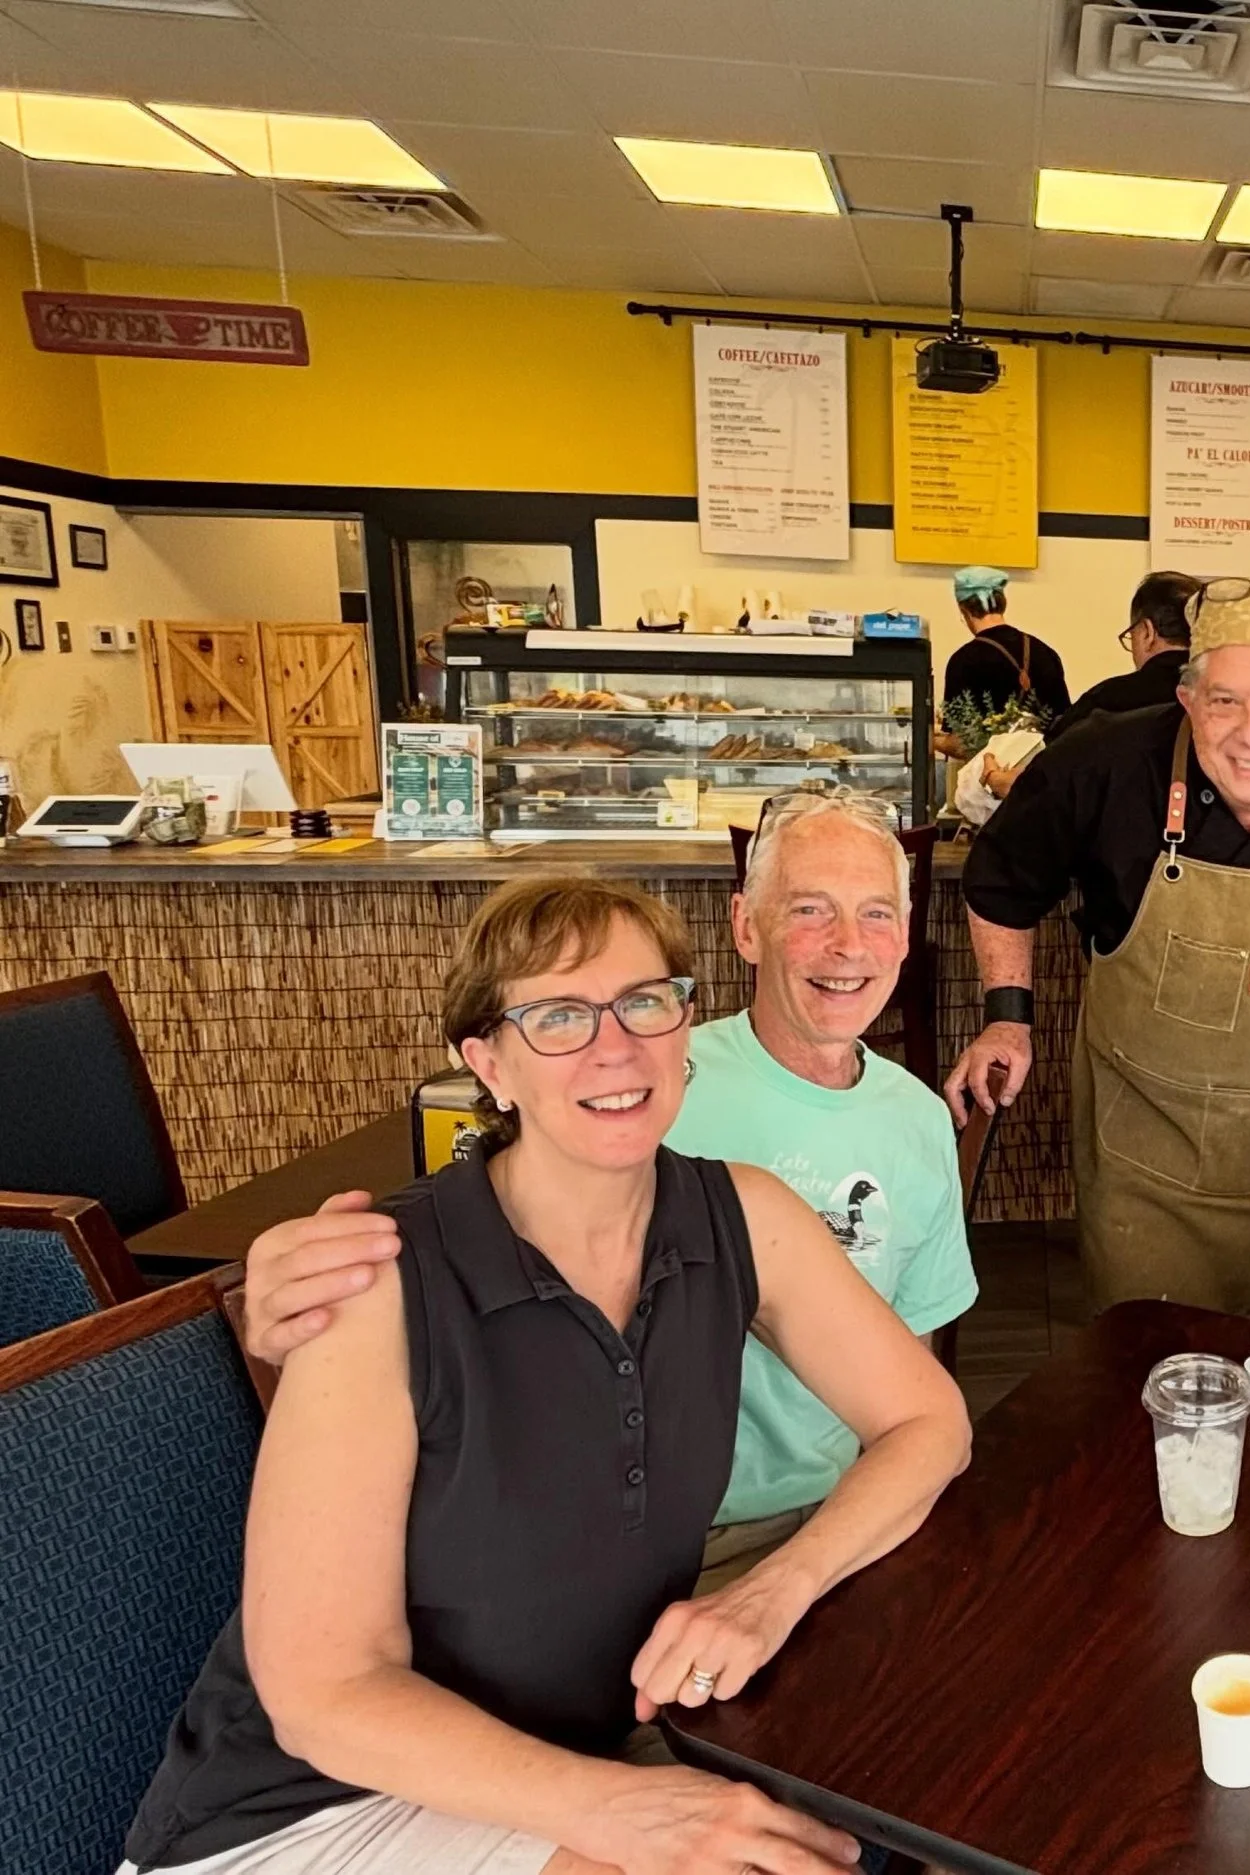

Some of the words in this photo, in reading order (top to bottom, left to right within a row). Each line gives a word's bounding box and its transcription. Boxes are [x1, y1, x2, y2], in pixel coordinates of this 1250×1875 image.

[46, 309, 163, 342] COFFEE
[213, 319, 291, 348] TIME
[718, 348, 821, 367] COFFEE/CAFETAZO
[1207, 448, 1219, 460] EL
